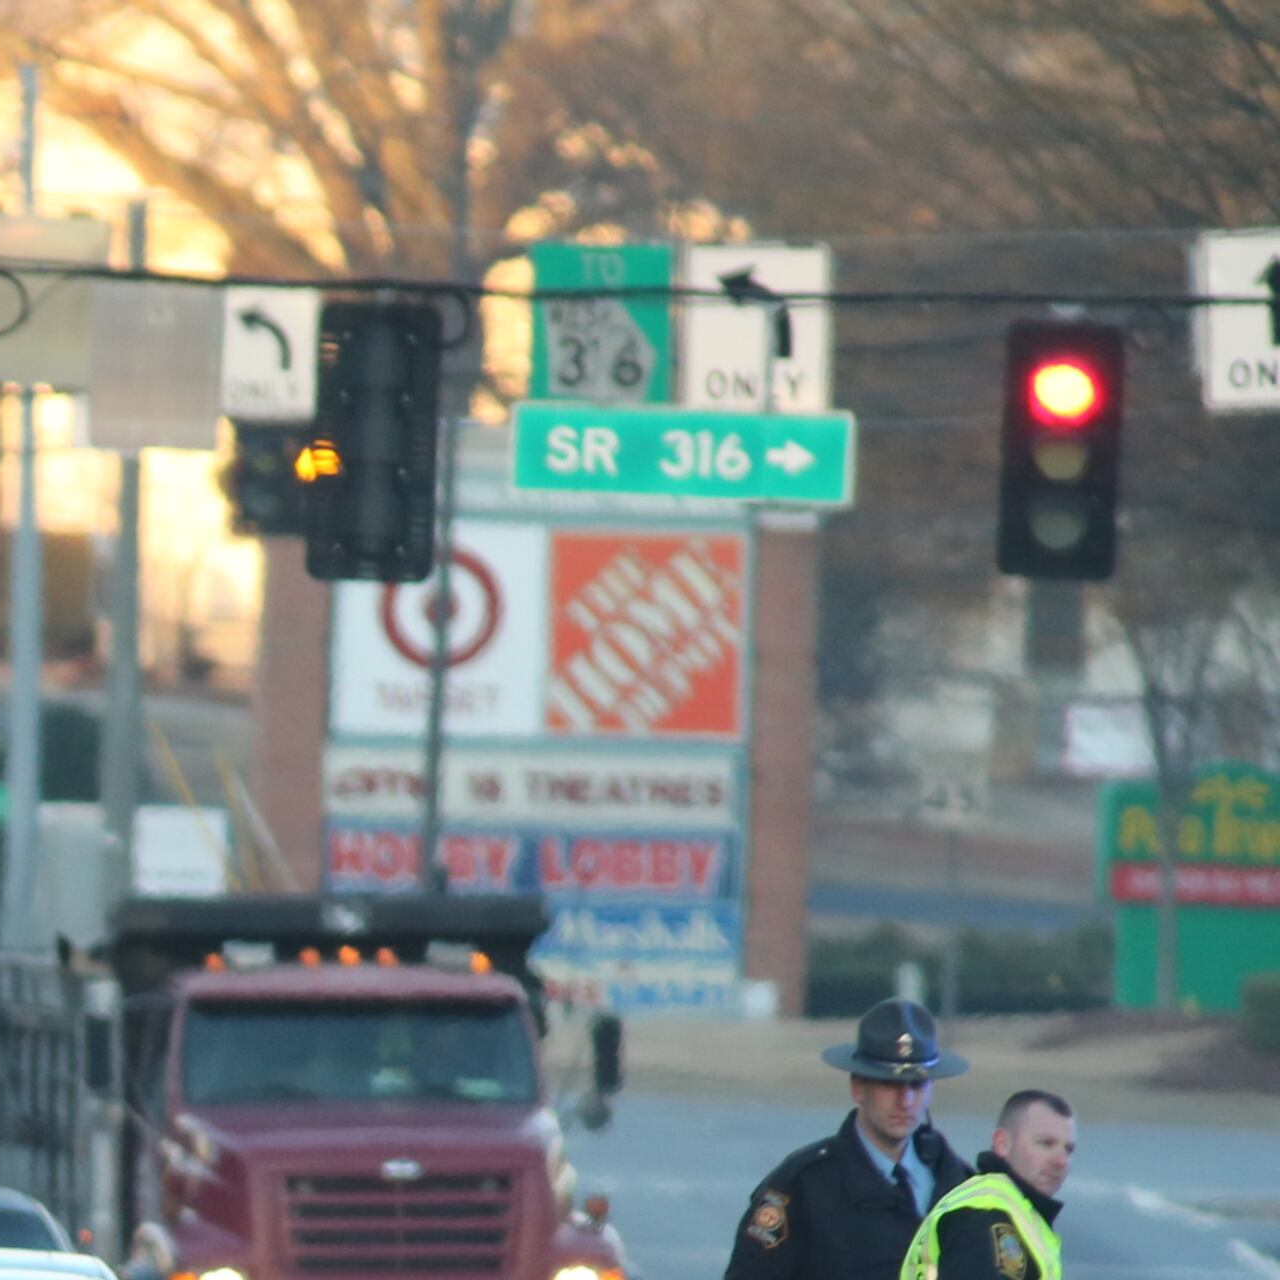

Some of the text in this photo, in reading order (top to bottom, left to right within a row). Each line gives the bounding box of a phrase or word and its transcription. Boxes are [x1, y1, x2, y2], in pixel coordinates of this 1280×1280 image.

[582, 253, 623, 286] TO
[558, 336, 641, 387] 36
[706, 370, 802, 400] ONY
[546, 425, 752, 480] SR 316
[540, 838, 720, 890] LOBBY
